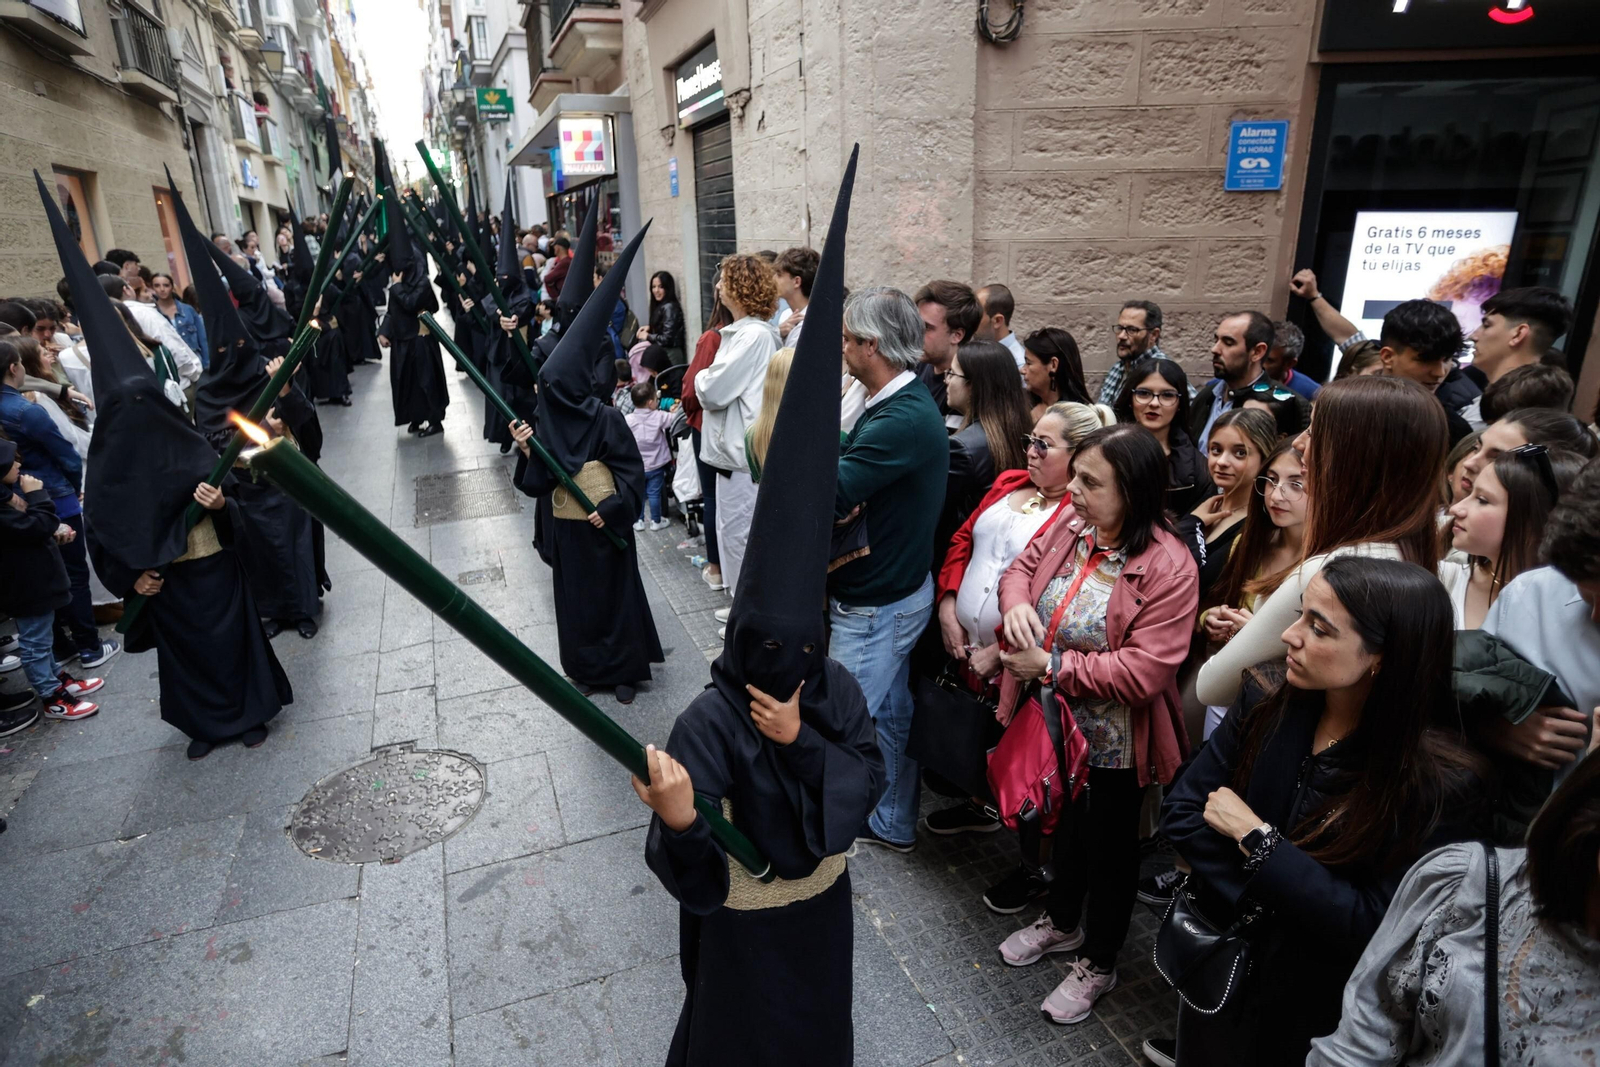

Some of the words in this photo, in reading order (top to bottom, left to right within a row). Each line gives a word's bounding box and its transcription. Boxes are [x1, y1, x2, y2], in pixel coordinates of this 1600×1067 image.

[1240, 127, 1277, 137] Alarma
[1238, 137, 1276, 145] conectada
[1237, 146, 1246, 154] 24
[1248, 145, 1274, 153] HORAS
[1367, 226, 1413, 239] Gratis
[1417, 226, 1427, 239] 6
[1431, 228, 1481, 239] meses
[1364, 243, 1382, 255] de
[1387, 243, 1400, 255] la
[1405, 243, 1424, 254] TV
[1427, 245, 1456, 257] que
[1362, 258, 1377, 271] tú
[1382, 259, 1421, 273] elijas
